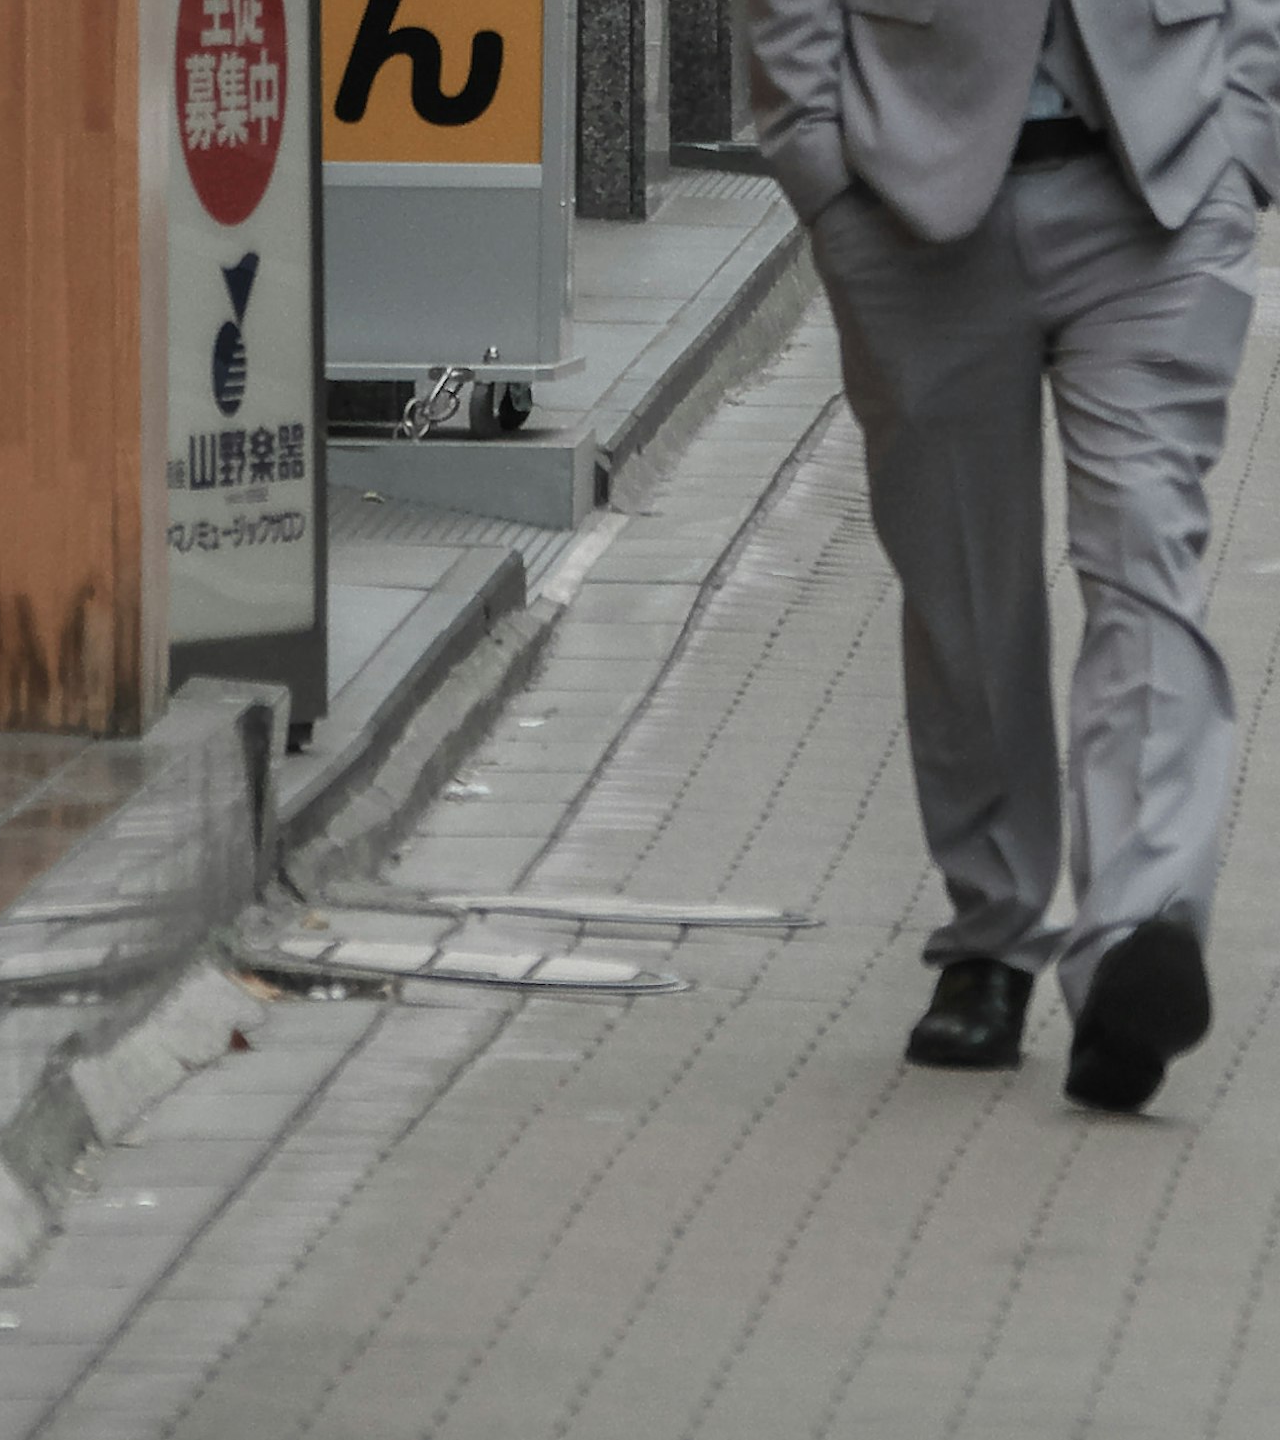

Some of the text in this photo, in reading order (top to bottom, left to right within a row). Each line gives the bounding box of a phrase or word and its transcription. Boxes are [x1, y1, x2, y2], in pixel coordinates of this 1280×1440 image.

[184, 48, 281, 153] 募集中
[188, 422, 306, 491] 山野楽器
